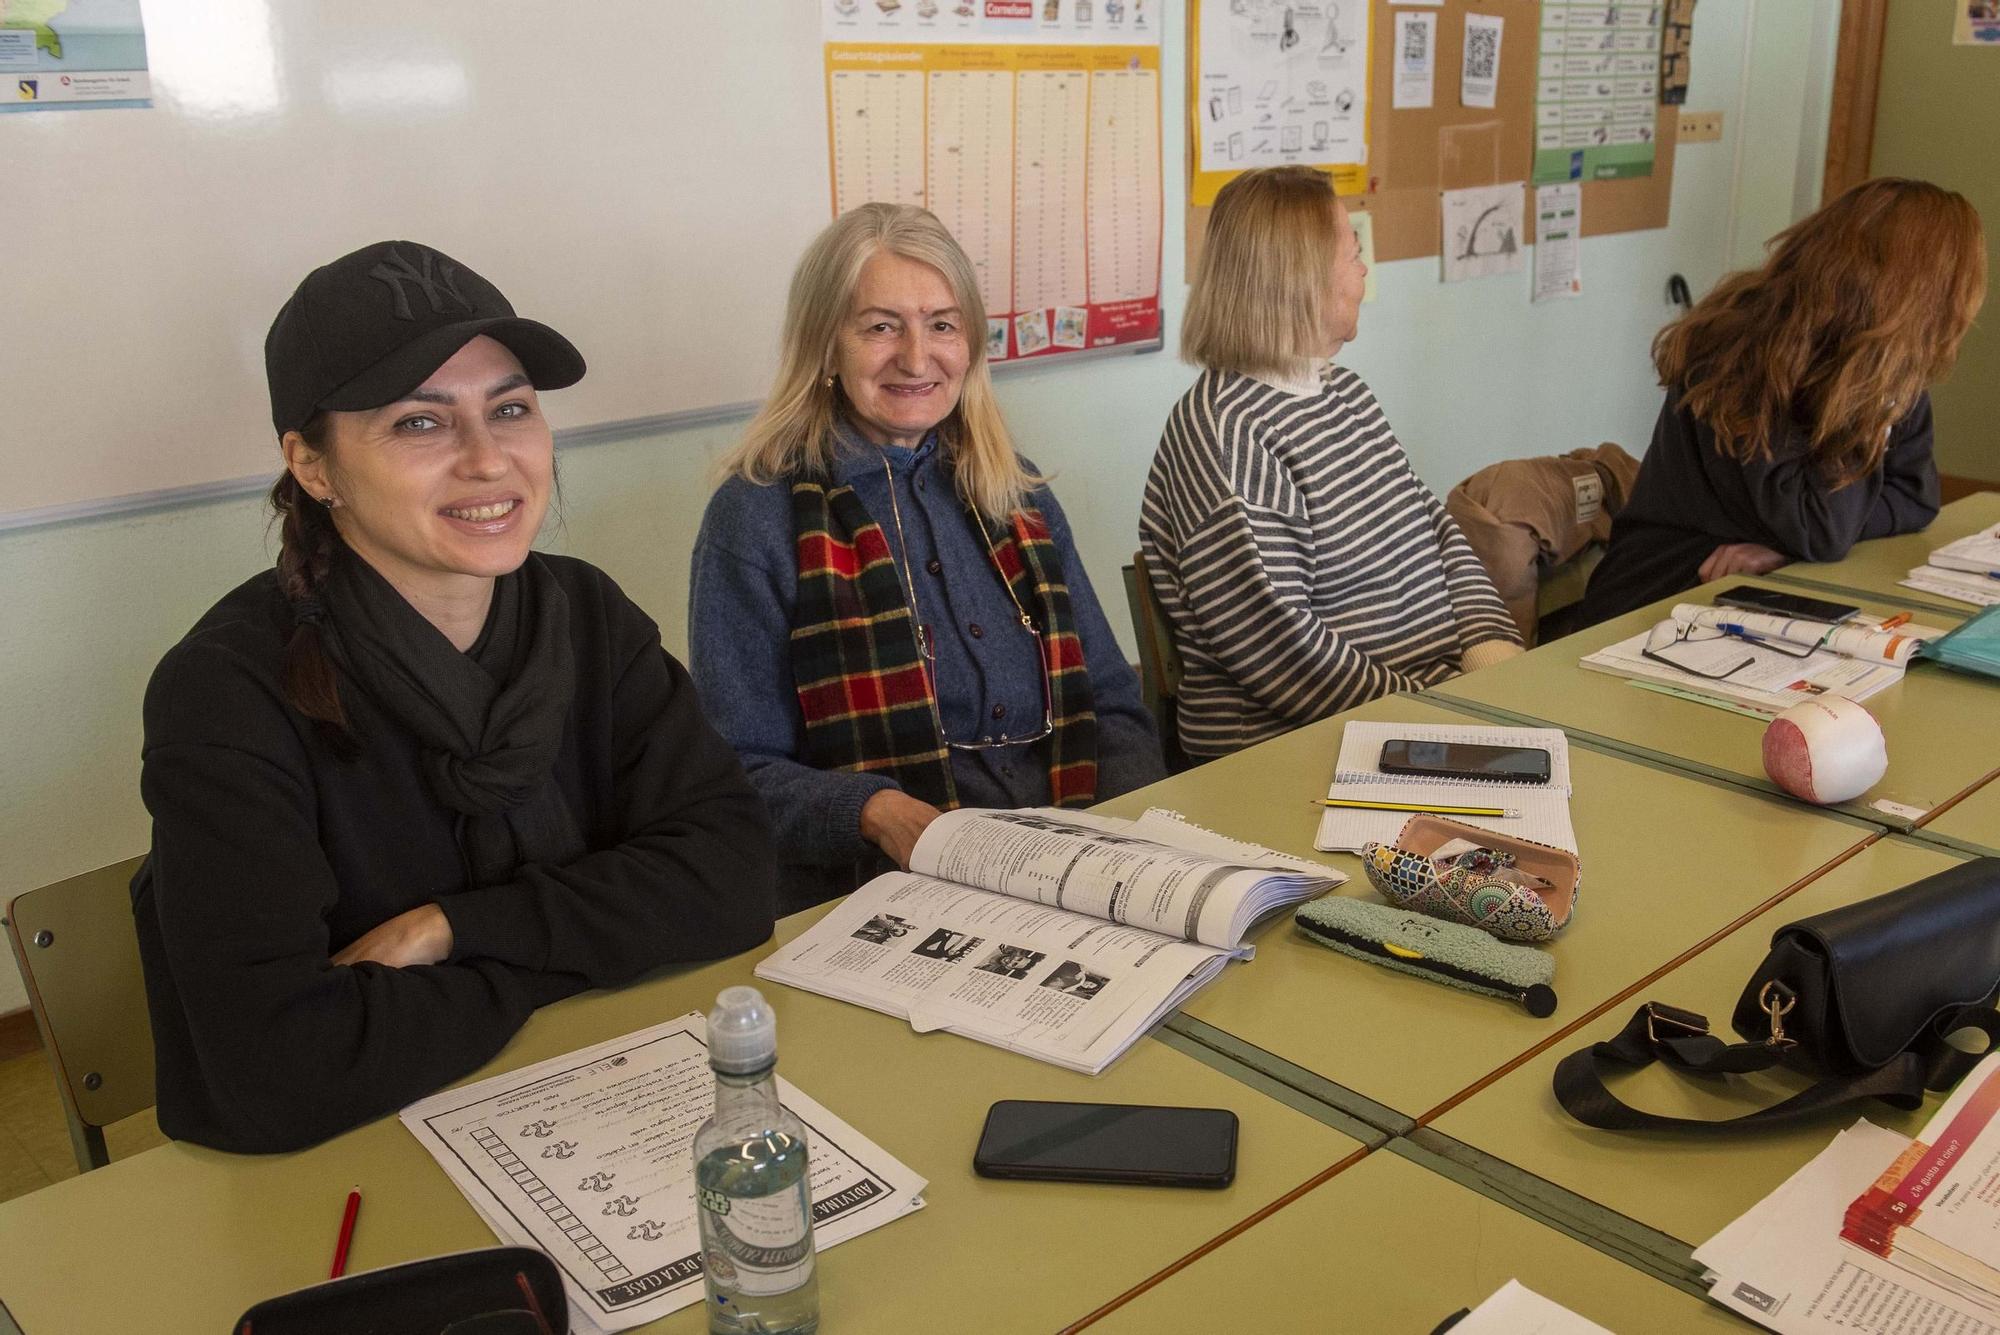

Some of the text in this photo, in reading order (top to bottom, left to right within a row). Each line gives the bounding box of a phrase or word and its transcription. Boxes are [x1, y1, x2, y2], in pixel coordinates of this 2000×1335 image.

[986, 2, 1031, 16] Cornelsen
[676, 1065, 699, 1073] tocan
[614, 1079, 662, 1096] instrumento
[593, 1101, 627, 1114] deporte
[661, 1101, 686, 1111] carne
[1920, 1166, 1941, 1187] gusta
[1943, 1139, 1960, 1160] cine?
[811, 1183, 876, 1214] ADIVINA:
[678, 1259, 698, 1272] DE
[660, 1267, 680, 1279] LA
